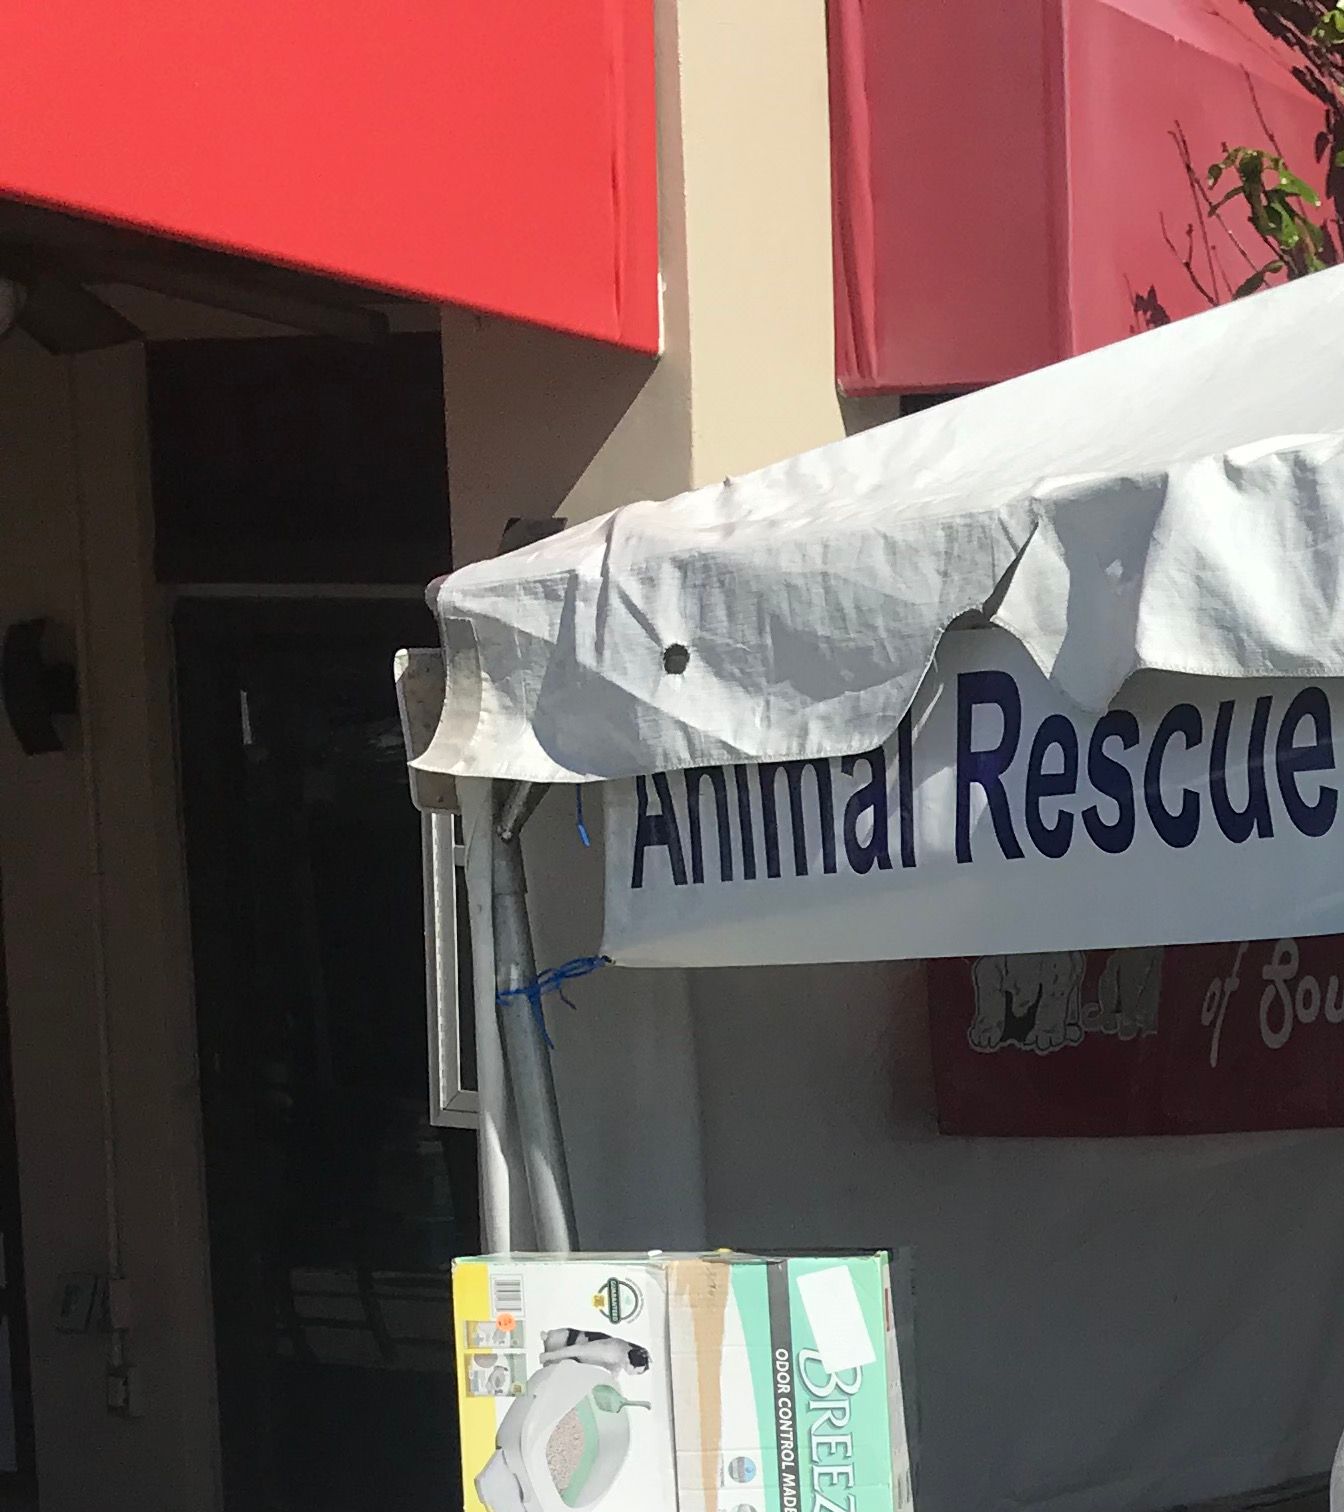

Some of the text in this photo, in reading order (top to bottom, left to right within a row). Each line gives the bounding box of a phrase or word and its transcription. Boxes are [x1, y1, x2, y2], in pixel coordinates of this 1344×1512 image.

[632, 710, 917, 889] Animal
[955, 670, 1339, 865] Rescue
[775, 1347, 792, 1394] ODOR
[777, 1398, 797, 1469] CONTROL
